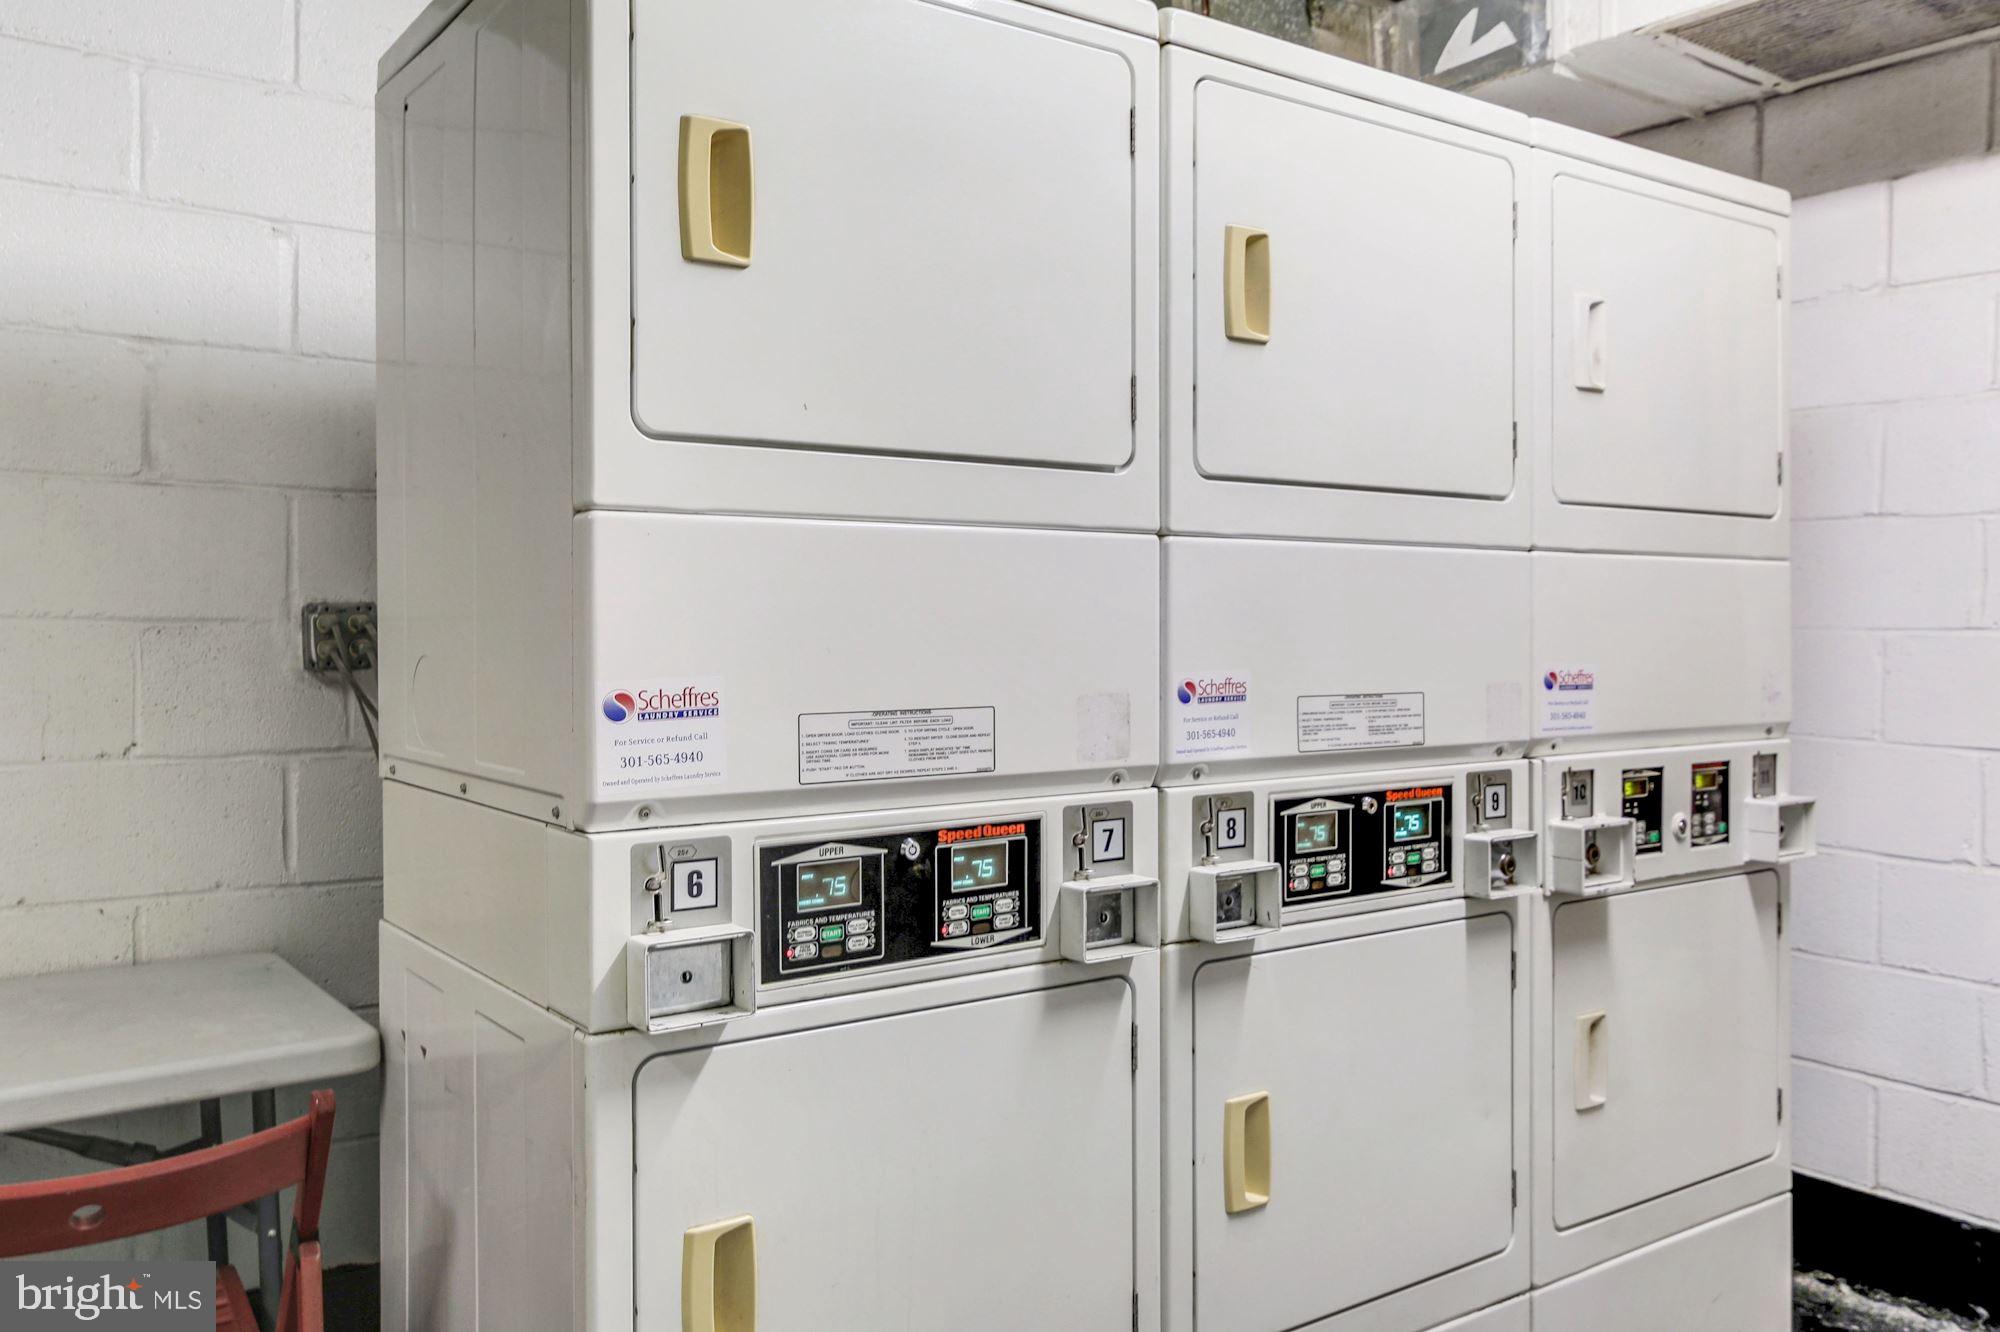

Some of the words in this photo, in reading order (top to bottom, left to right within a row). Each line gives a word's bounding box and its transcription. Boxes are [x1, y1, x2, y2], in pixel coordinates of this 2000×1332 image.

[1198, 677, 1247, 696] Scheffres
[638, 687, 719, 711] Scheffres
[638, 711, 679, 721] LAUNDRY
[683, 708, 719, 718] SERVICE
[614, 739, 626, 747] For
[628, 736, 655, 746] Service
[666, 734, 693, 743] Refund
[693, 732, 708, 741] Call
[1186, 728, 1235, 741] 301-565-4940
[620, 751, 704, 769] 301-565-4940
[1386, 790, 1414, 802] Speed
[1415, 788, 1443, 798] Queen
[1574, 784, 1586, 800] 10
[1492, 792, 1499, 811] 9
[938, 826, 982, 844] Speed
[983, 823, 1025, 837] Queen
[1227, 818, 1236, 840] 8
[1102, 828, 1114, 852] 7
[819, 846, 844, 856] UPPER
[687, 869, 703, 898] 6
[943, 897, 965, 906] FABRICS
[979, 890, 1019, 901] TEMPERATURES
[787, 917, 814, 928] FABRICS
[815, 916, 828, 924] AND
[829, 910, 875, 922] TEMPERATURES
[822, 929, 842, 938] START
[971, 935, 995, 945] LOWER
